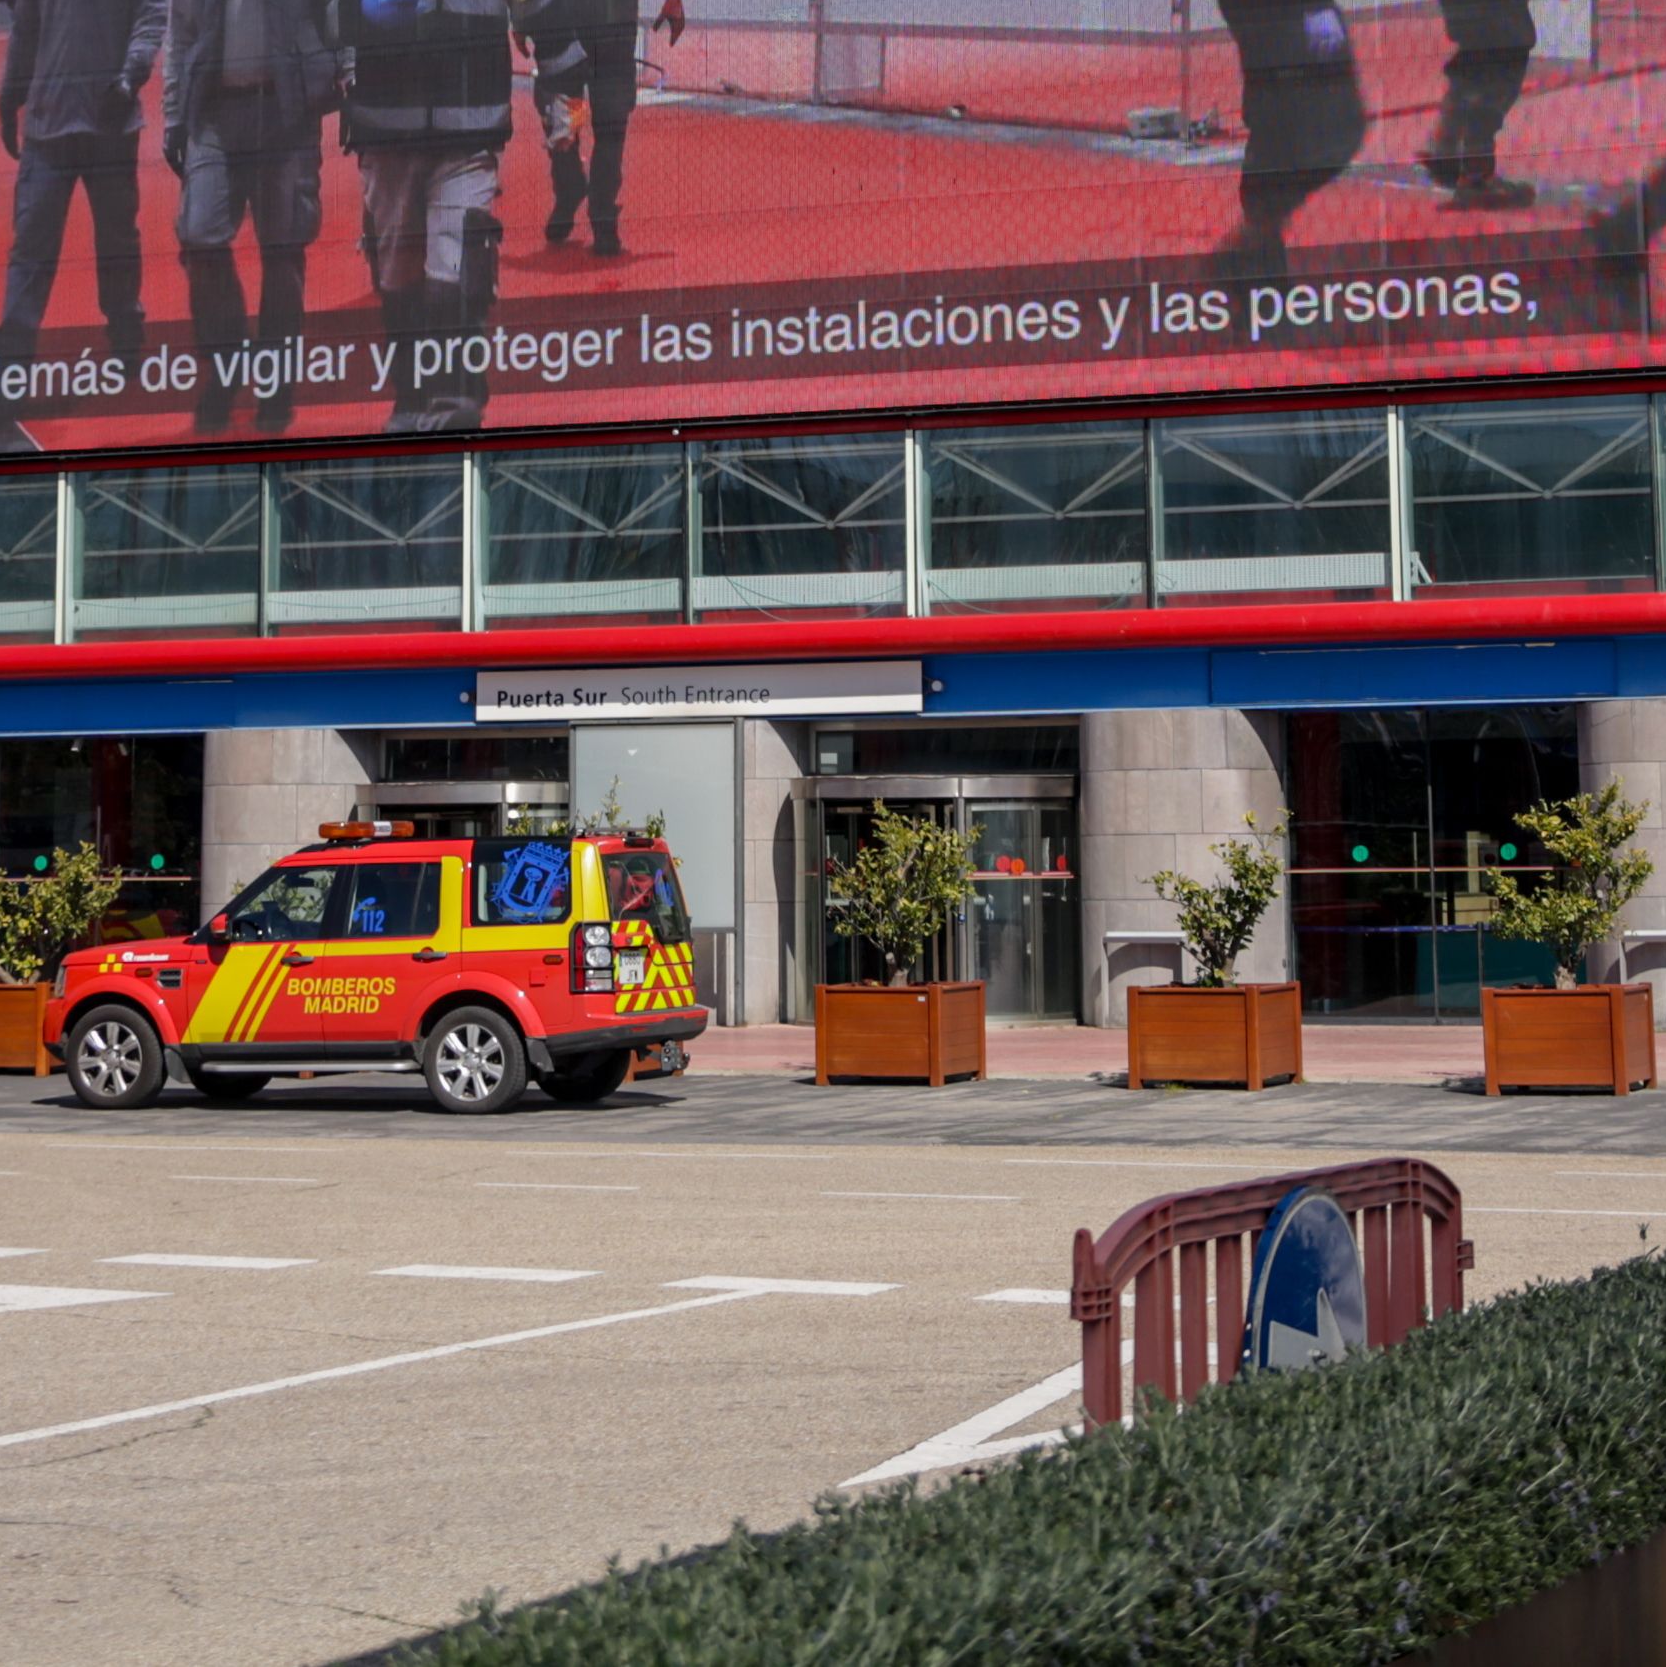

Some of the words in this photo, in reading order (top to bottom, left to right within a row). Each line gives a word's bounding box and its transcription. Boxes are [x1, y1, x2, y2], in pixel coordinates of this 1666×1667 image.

[140, 342, 198, 393] de
[213, 335, 356, 400] vigilar
[369, 340, 397, 392] y
[412, 324, 623, 389] proteger
[640, 314, 714, 364] las
[731, 295, 1082, 359] instalaciones
[1098, 297, 1131, 350] y
[1149, 281, 1231, 333] las
[1248, 268, 1539, 341] personas,
[497, 689, 565, 709] Puerta
[572, 687, 608, 706] Sur
[620, 685, 677, 705] South
[685, 684, 771, 704] Entrance
[361, 909, 386, 933] 112
[286, 977, 396, 996] BOMBEROS
[303, 996, 380, 1014] MADRID
